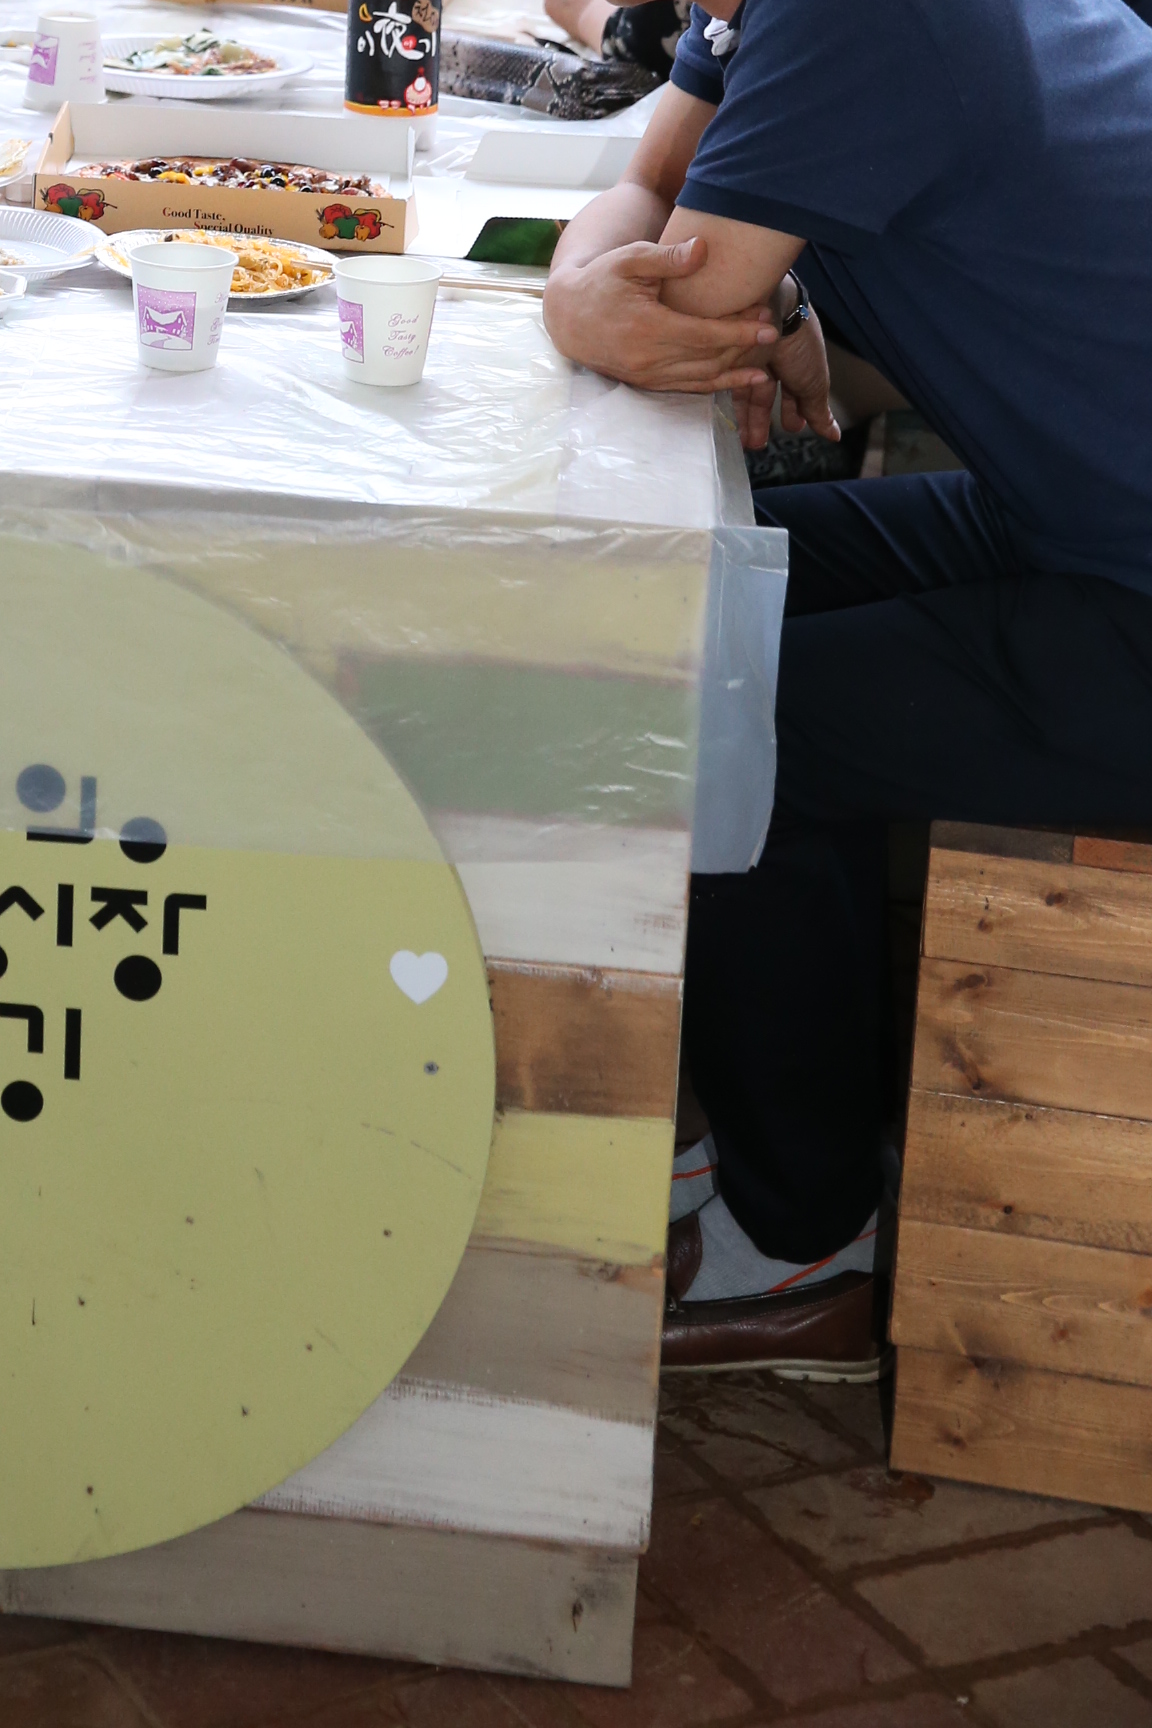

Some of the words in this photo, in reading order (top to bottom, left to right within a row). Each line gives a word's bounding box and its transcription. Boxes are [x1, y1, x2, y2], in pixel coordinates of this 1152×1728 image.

[162, 207, 192, 220] Good
[193, 209, 226, 221] Taste,
[388, 313, 419, 327] Good
[388, 330, 416, 344] Tasty
